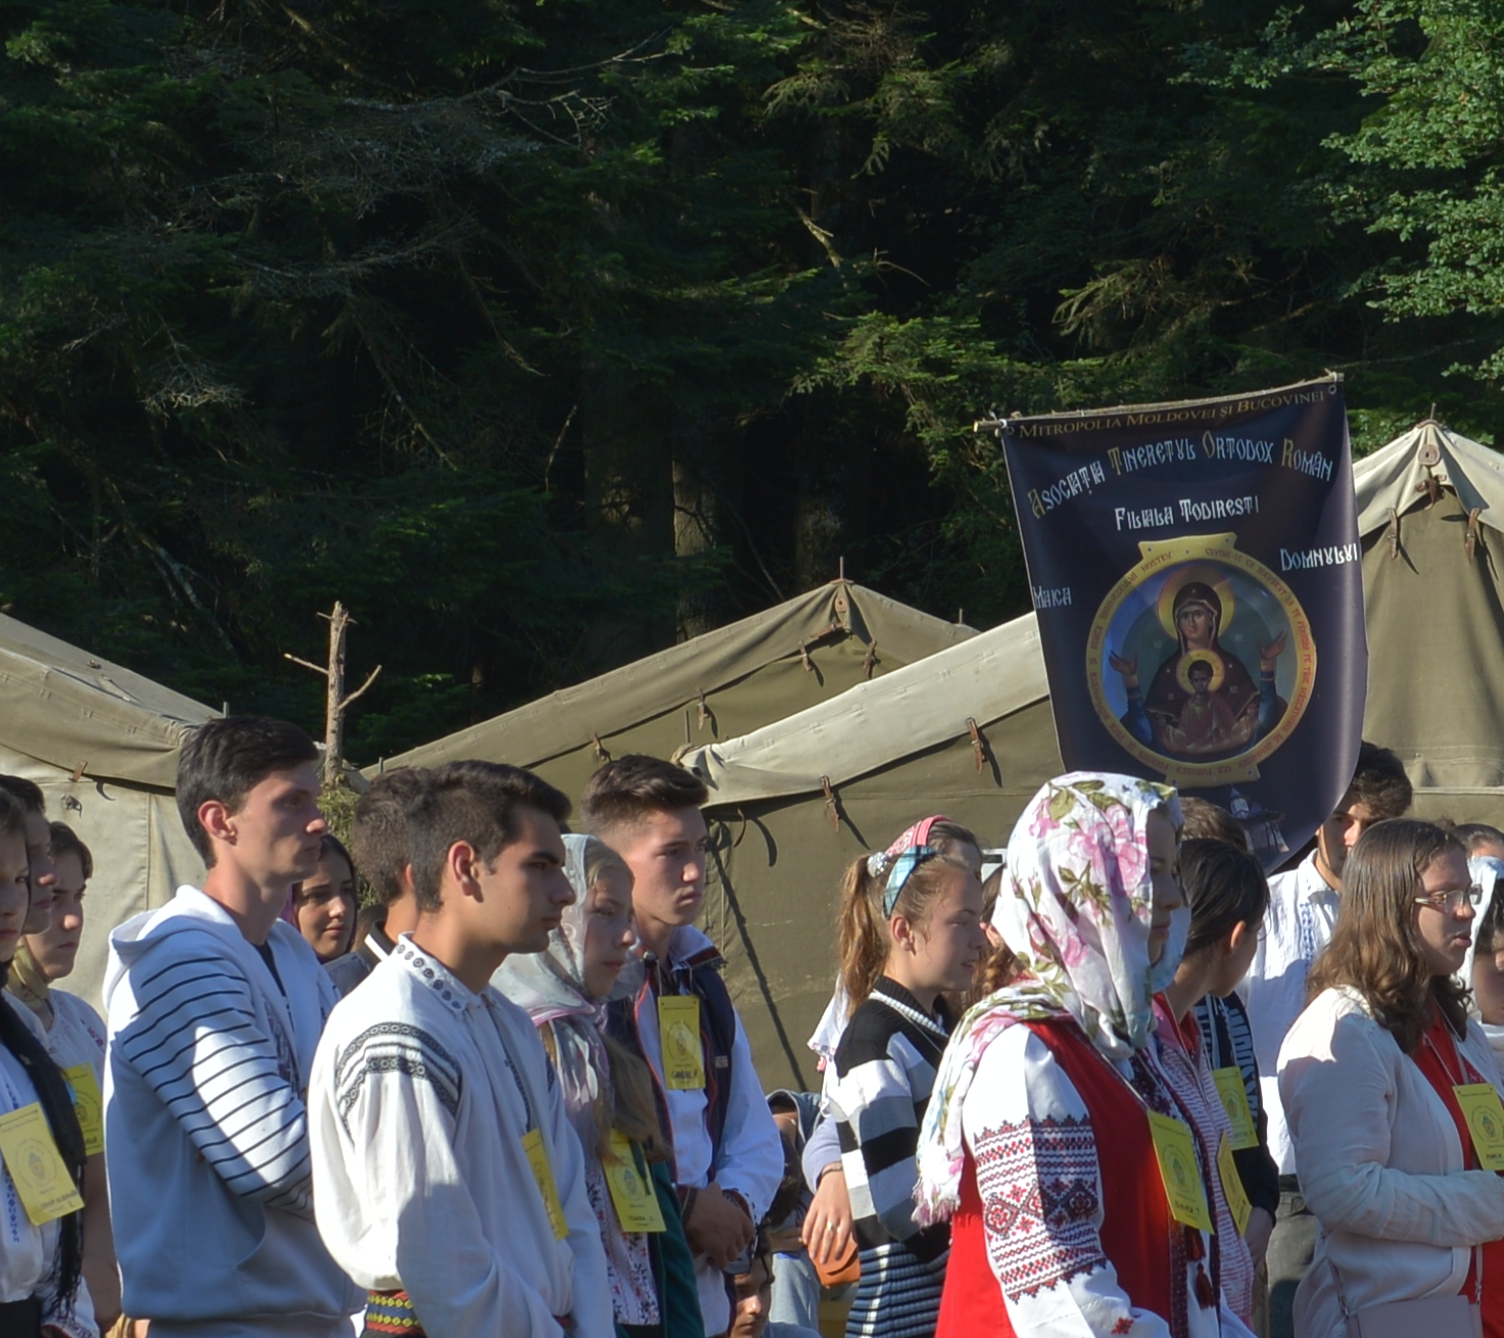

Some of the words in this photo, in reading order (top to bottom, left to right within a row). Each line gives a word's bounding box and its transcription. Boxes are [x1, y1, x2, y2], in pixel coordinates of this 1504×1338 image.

[1019, 418, 1122, 438] MITROPOLIA
[1126, 410, 1215, 427] MOLDOVEI
[1237, 391, 1324, 412] BUCOVINEI
